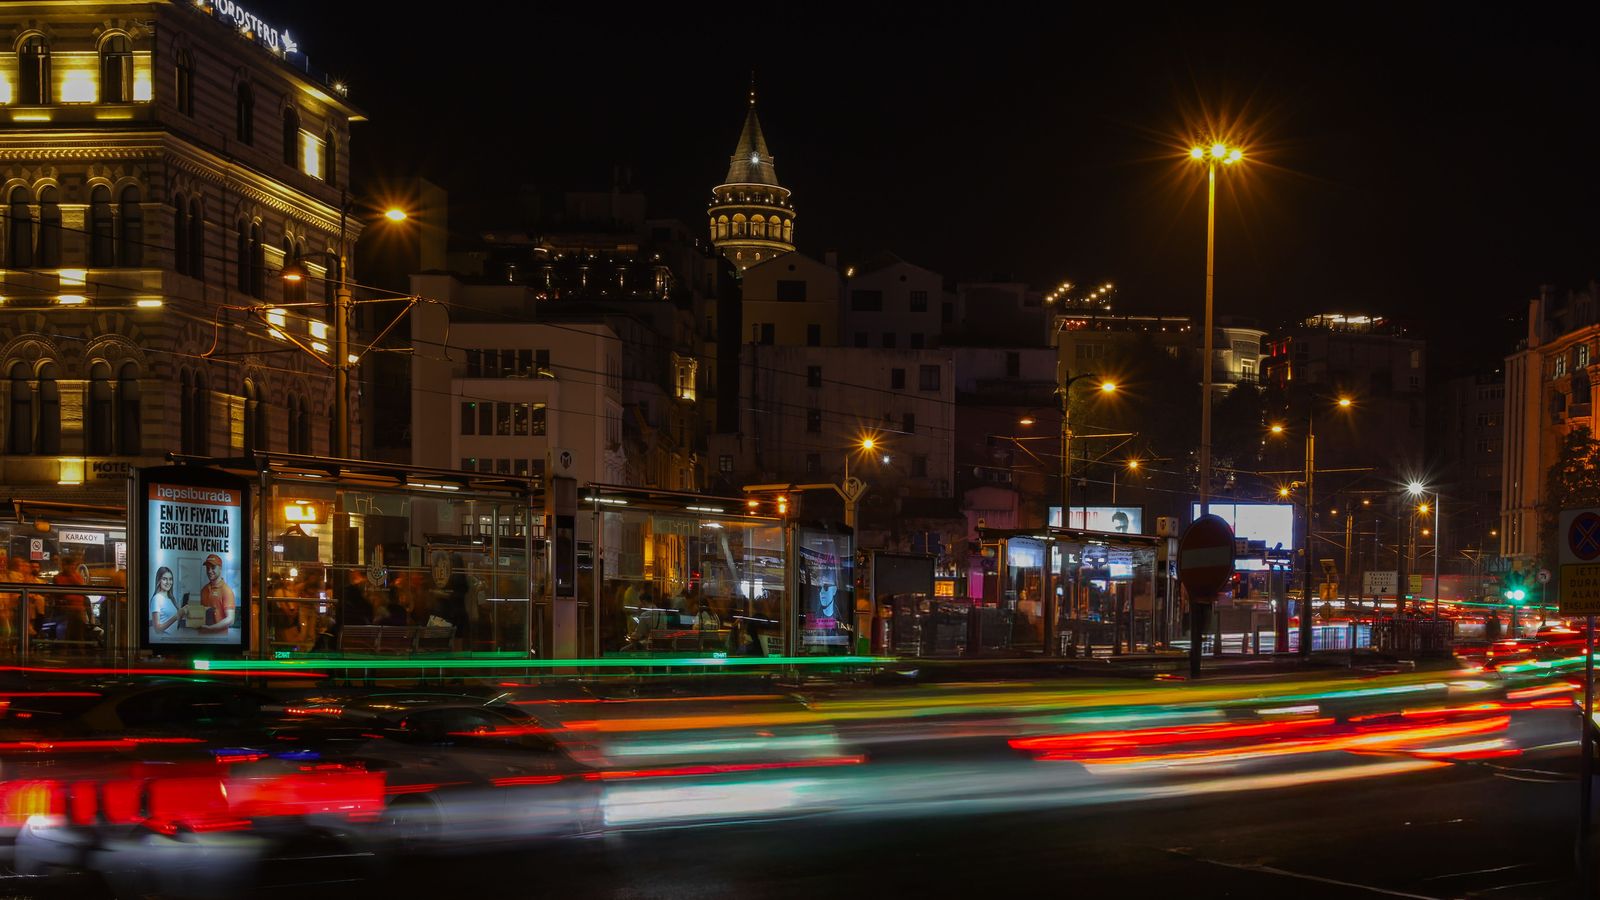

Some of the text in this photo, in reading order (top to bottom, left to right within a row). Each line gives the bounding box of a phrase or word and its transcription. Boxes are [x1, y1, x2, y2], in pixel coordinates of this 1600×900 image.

[157, 484, 232, 502] hepsiburada
[160, 505, 173, 521] EN
[190, 507, 229, 525] FİYATLA
[160, 522, 229, 538] ESKİ TELEFONUNU
[160, 536, 229, 553] KAPINDA YENİLE
[1570, 578, 1600, 588] DURA
[1571, 590, 1600, 599] ALAN
